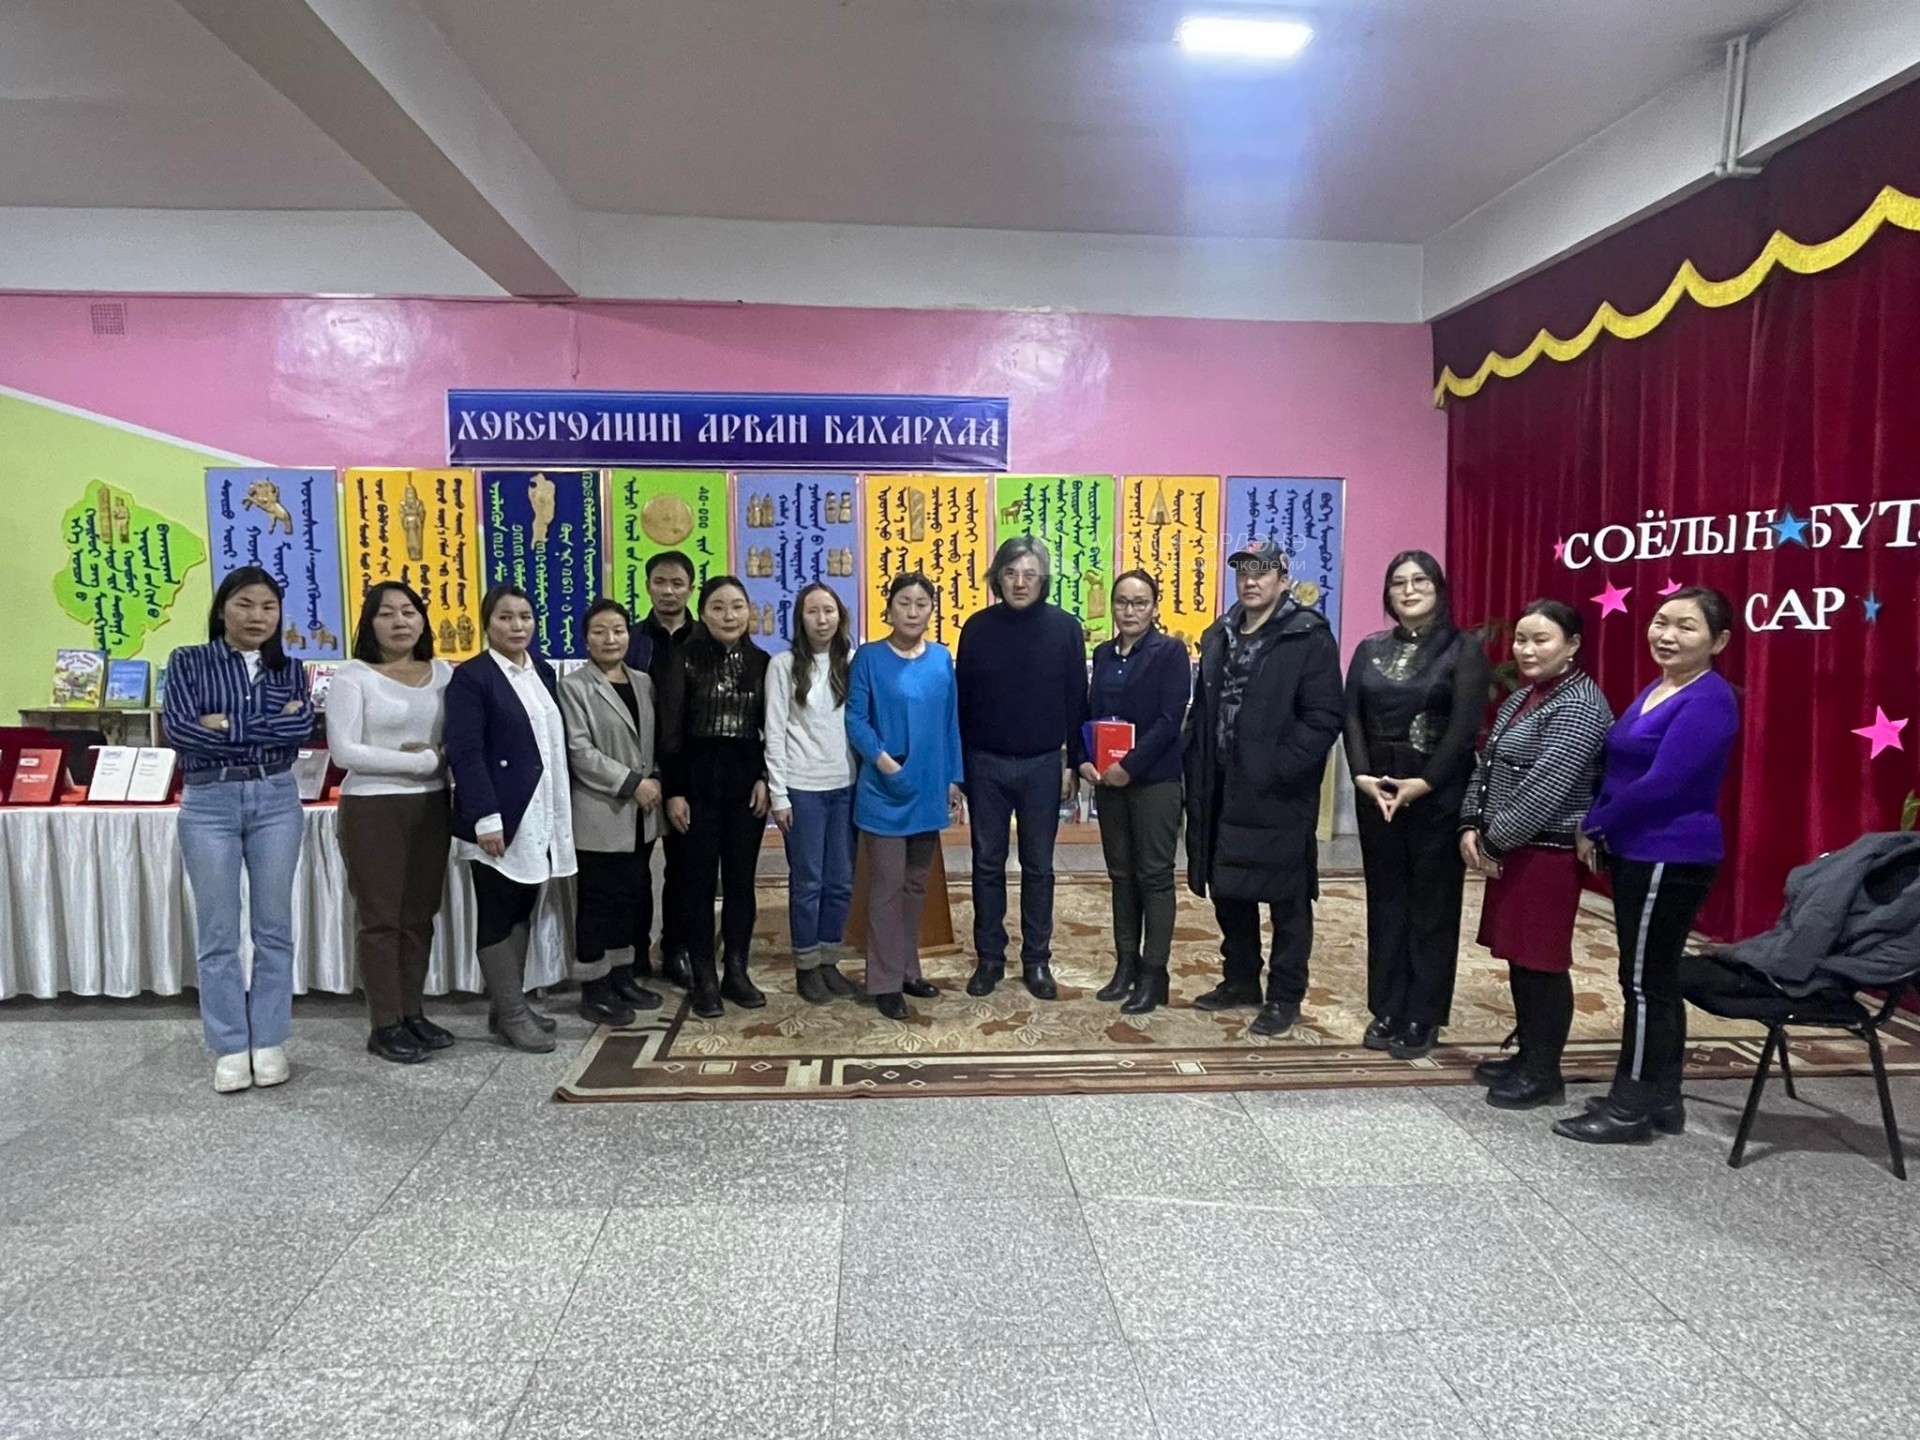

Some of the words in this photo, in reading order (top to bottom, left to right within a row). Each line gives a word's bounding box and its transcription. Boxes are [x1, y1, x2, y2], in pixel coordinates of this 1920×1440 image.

[698, 412, 808, 444] АРВАН
[825, 414, 1000, 447] БАХАРХАЛ
[1562, 509, 1777, 570] СОЁЛЫН
[1810, 499, 1920, 549] БҮТ
[1744, 587, 1846, 633] САР
